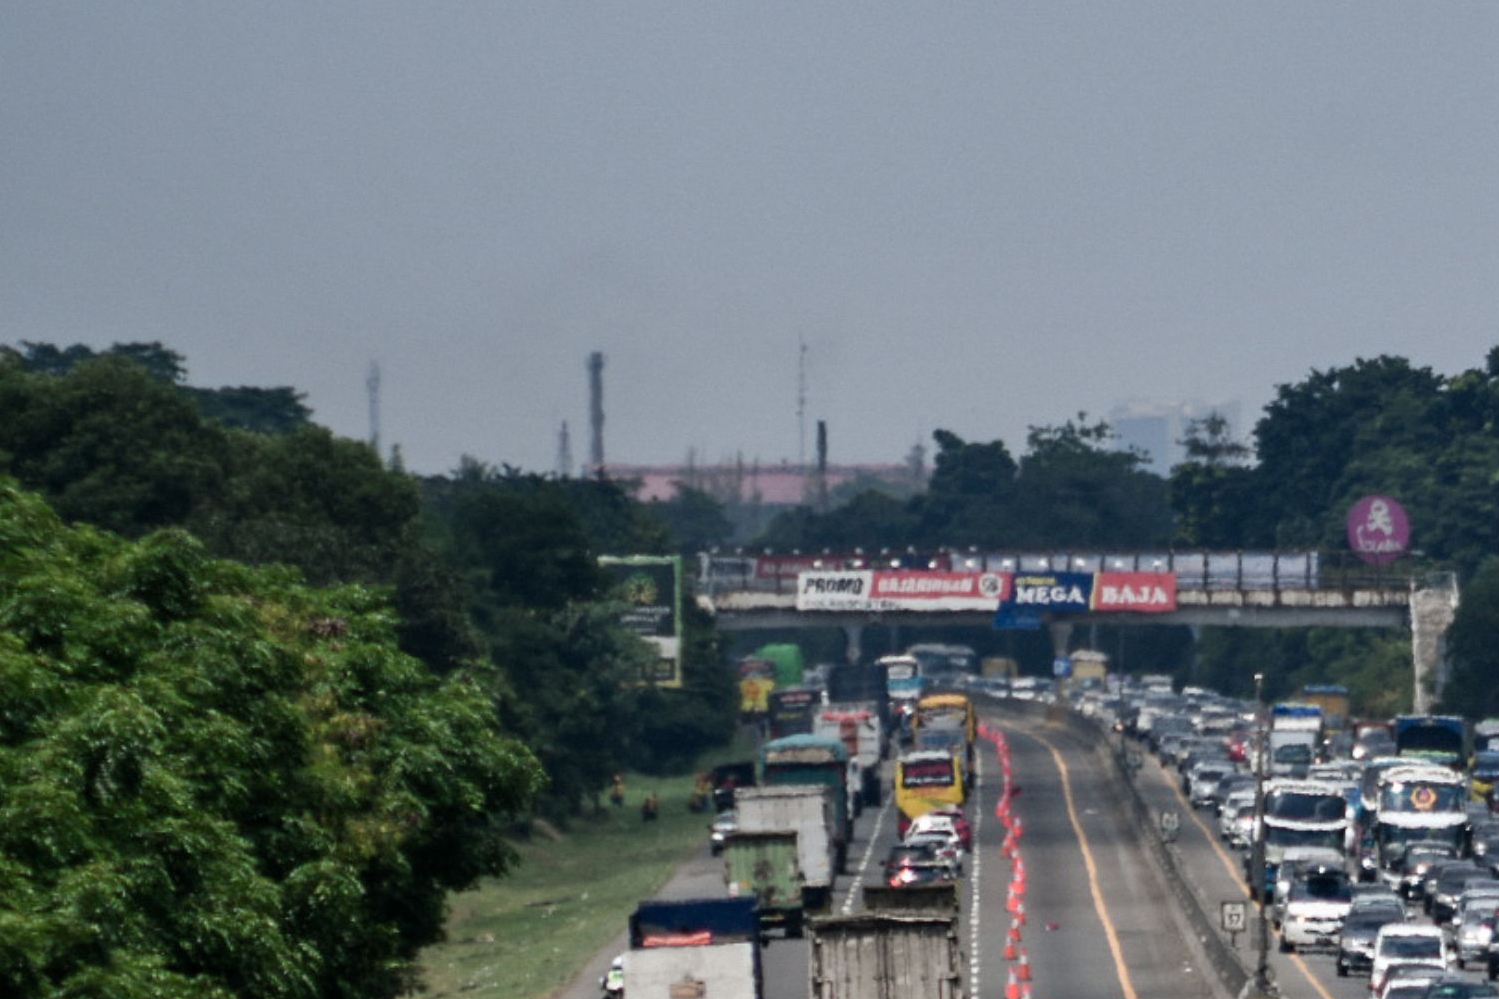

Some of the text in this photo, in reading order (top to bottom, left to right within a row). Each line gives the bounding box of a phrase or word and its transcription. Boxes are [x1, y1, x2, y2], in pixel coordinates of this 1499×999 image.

[803, 577, 864, 595] PROMO
[1101, 586, 1168, 604] BAJA
[1015, 586, 1085, 605] MEGA
